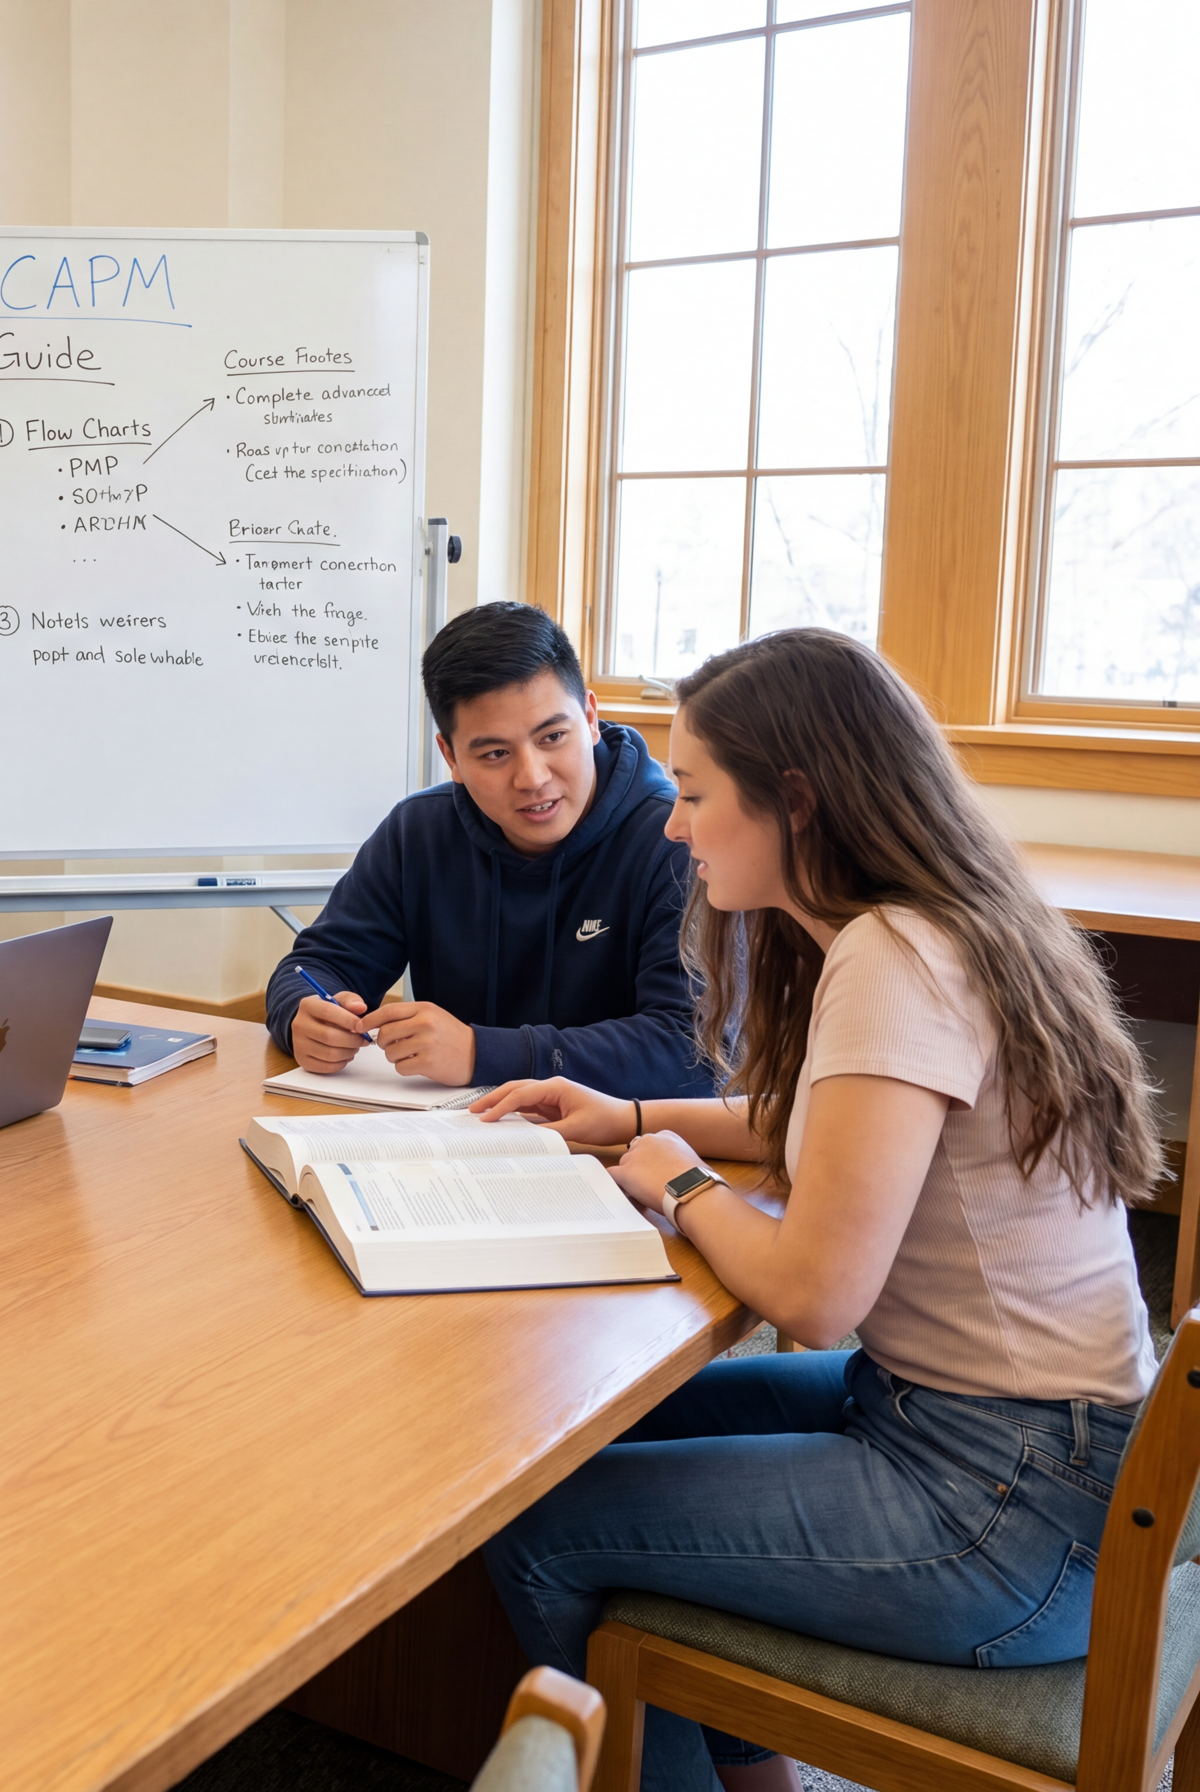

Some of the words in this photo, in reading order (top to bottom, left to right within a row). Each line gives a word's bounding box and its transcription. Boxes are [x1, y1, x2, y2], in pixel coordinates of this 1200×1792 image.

[0, 253, 176, 311] CAPM
[224, 349, 286, 370] Course
[235, 386, 314, 409] Complete
[26, 418, 73, 442] Flow
[82, 417, 152, 439] Charts
[70, 455, 119, 478] PMP
[284, 465, 307, 479] the
[291, 603, 317, 618] the
[76, 645, 106, 664] and
[581, 919, 602, 933] NIKE
